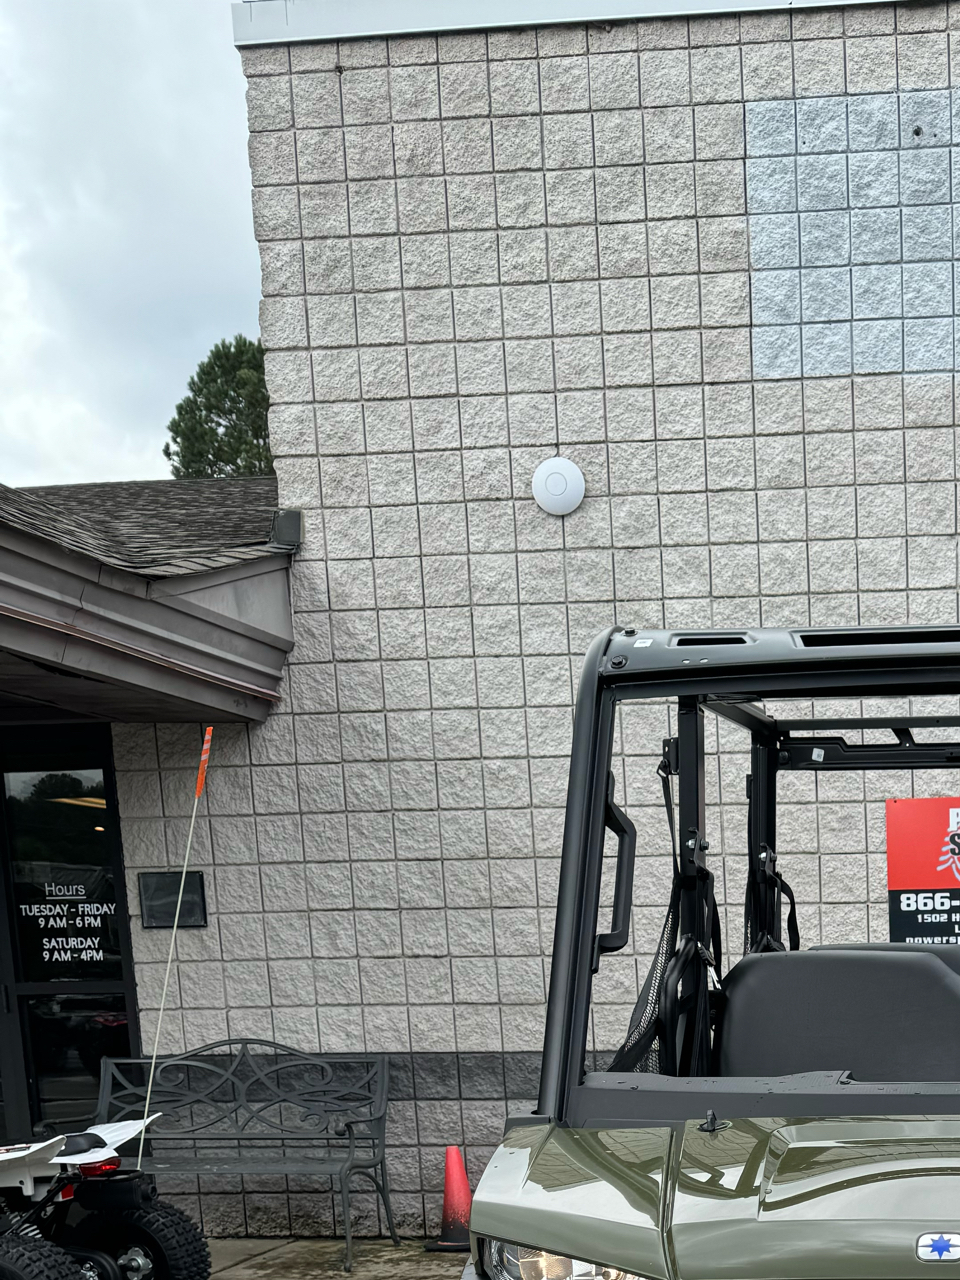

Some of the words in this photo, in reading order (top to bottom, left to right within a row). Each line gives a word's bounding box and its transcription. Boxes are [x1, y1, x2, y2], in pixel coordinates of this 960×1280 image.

[44, 882, 86, 896] Hours
[20, 904, 69, 916] TUESDAY
[78, 903, 116, 915] FRIDAY
[38, 917, 46, 928] 9
[47, 916, 67, 928] AM
[75, 916, 83, 928] 6
[84, 916, 101, 928] PM
[917, 913, 948, 922] 1502
[42, 937, 100, 949] SATURDAY
[42, 950, 50, 962] 9
[52, 950, 72, 962] AM
[80, 949, 104, 962] 4PM
